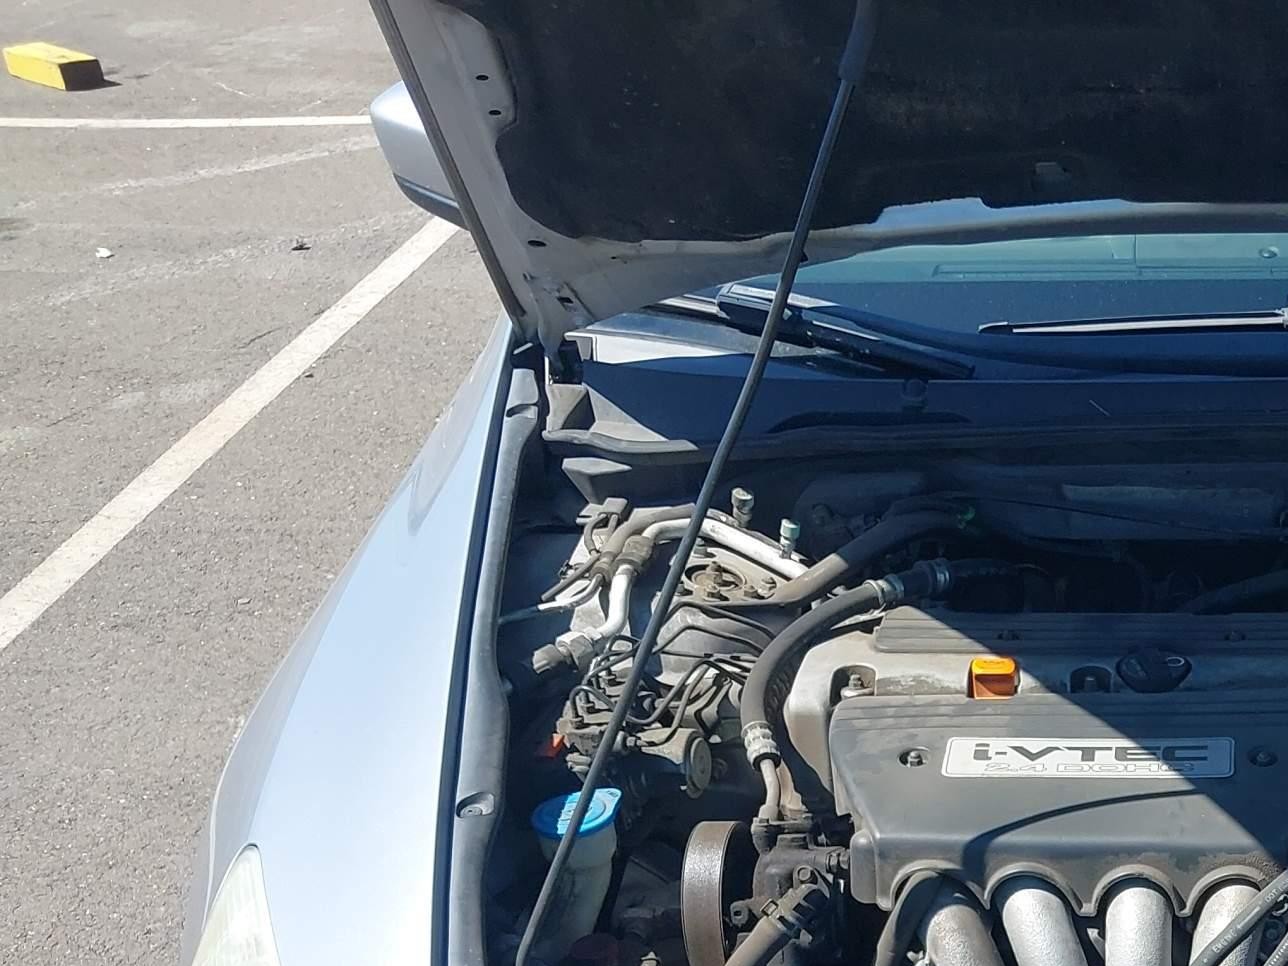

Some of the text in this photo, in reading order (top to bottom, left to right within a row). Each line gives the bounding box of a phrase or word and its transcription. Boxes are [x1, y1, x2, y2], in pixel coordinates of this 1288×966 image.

[973, 742, 1209, 763] i-VTEC
[984, 762, 1195, 774] 2.4 DOHC
